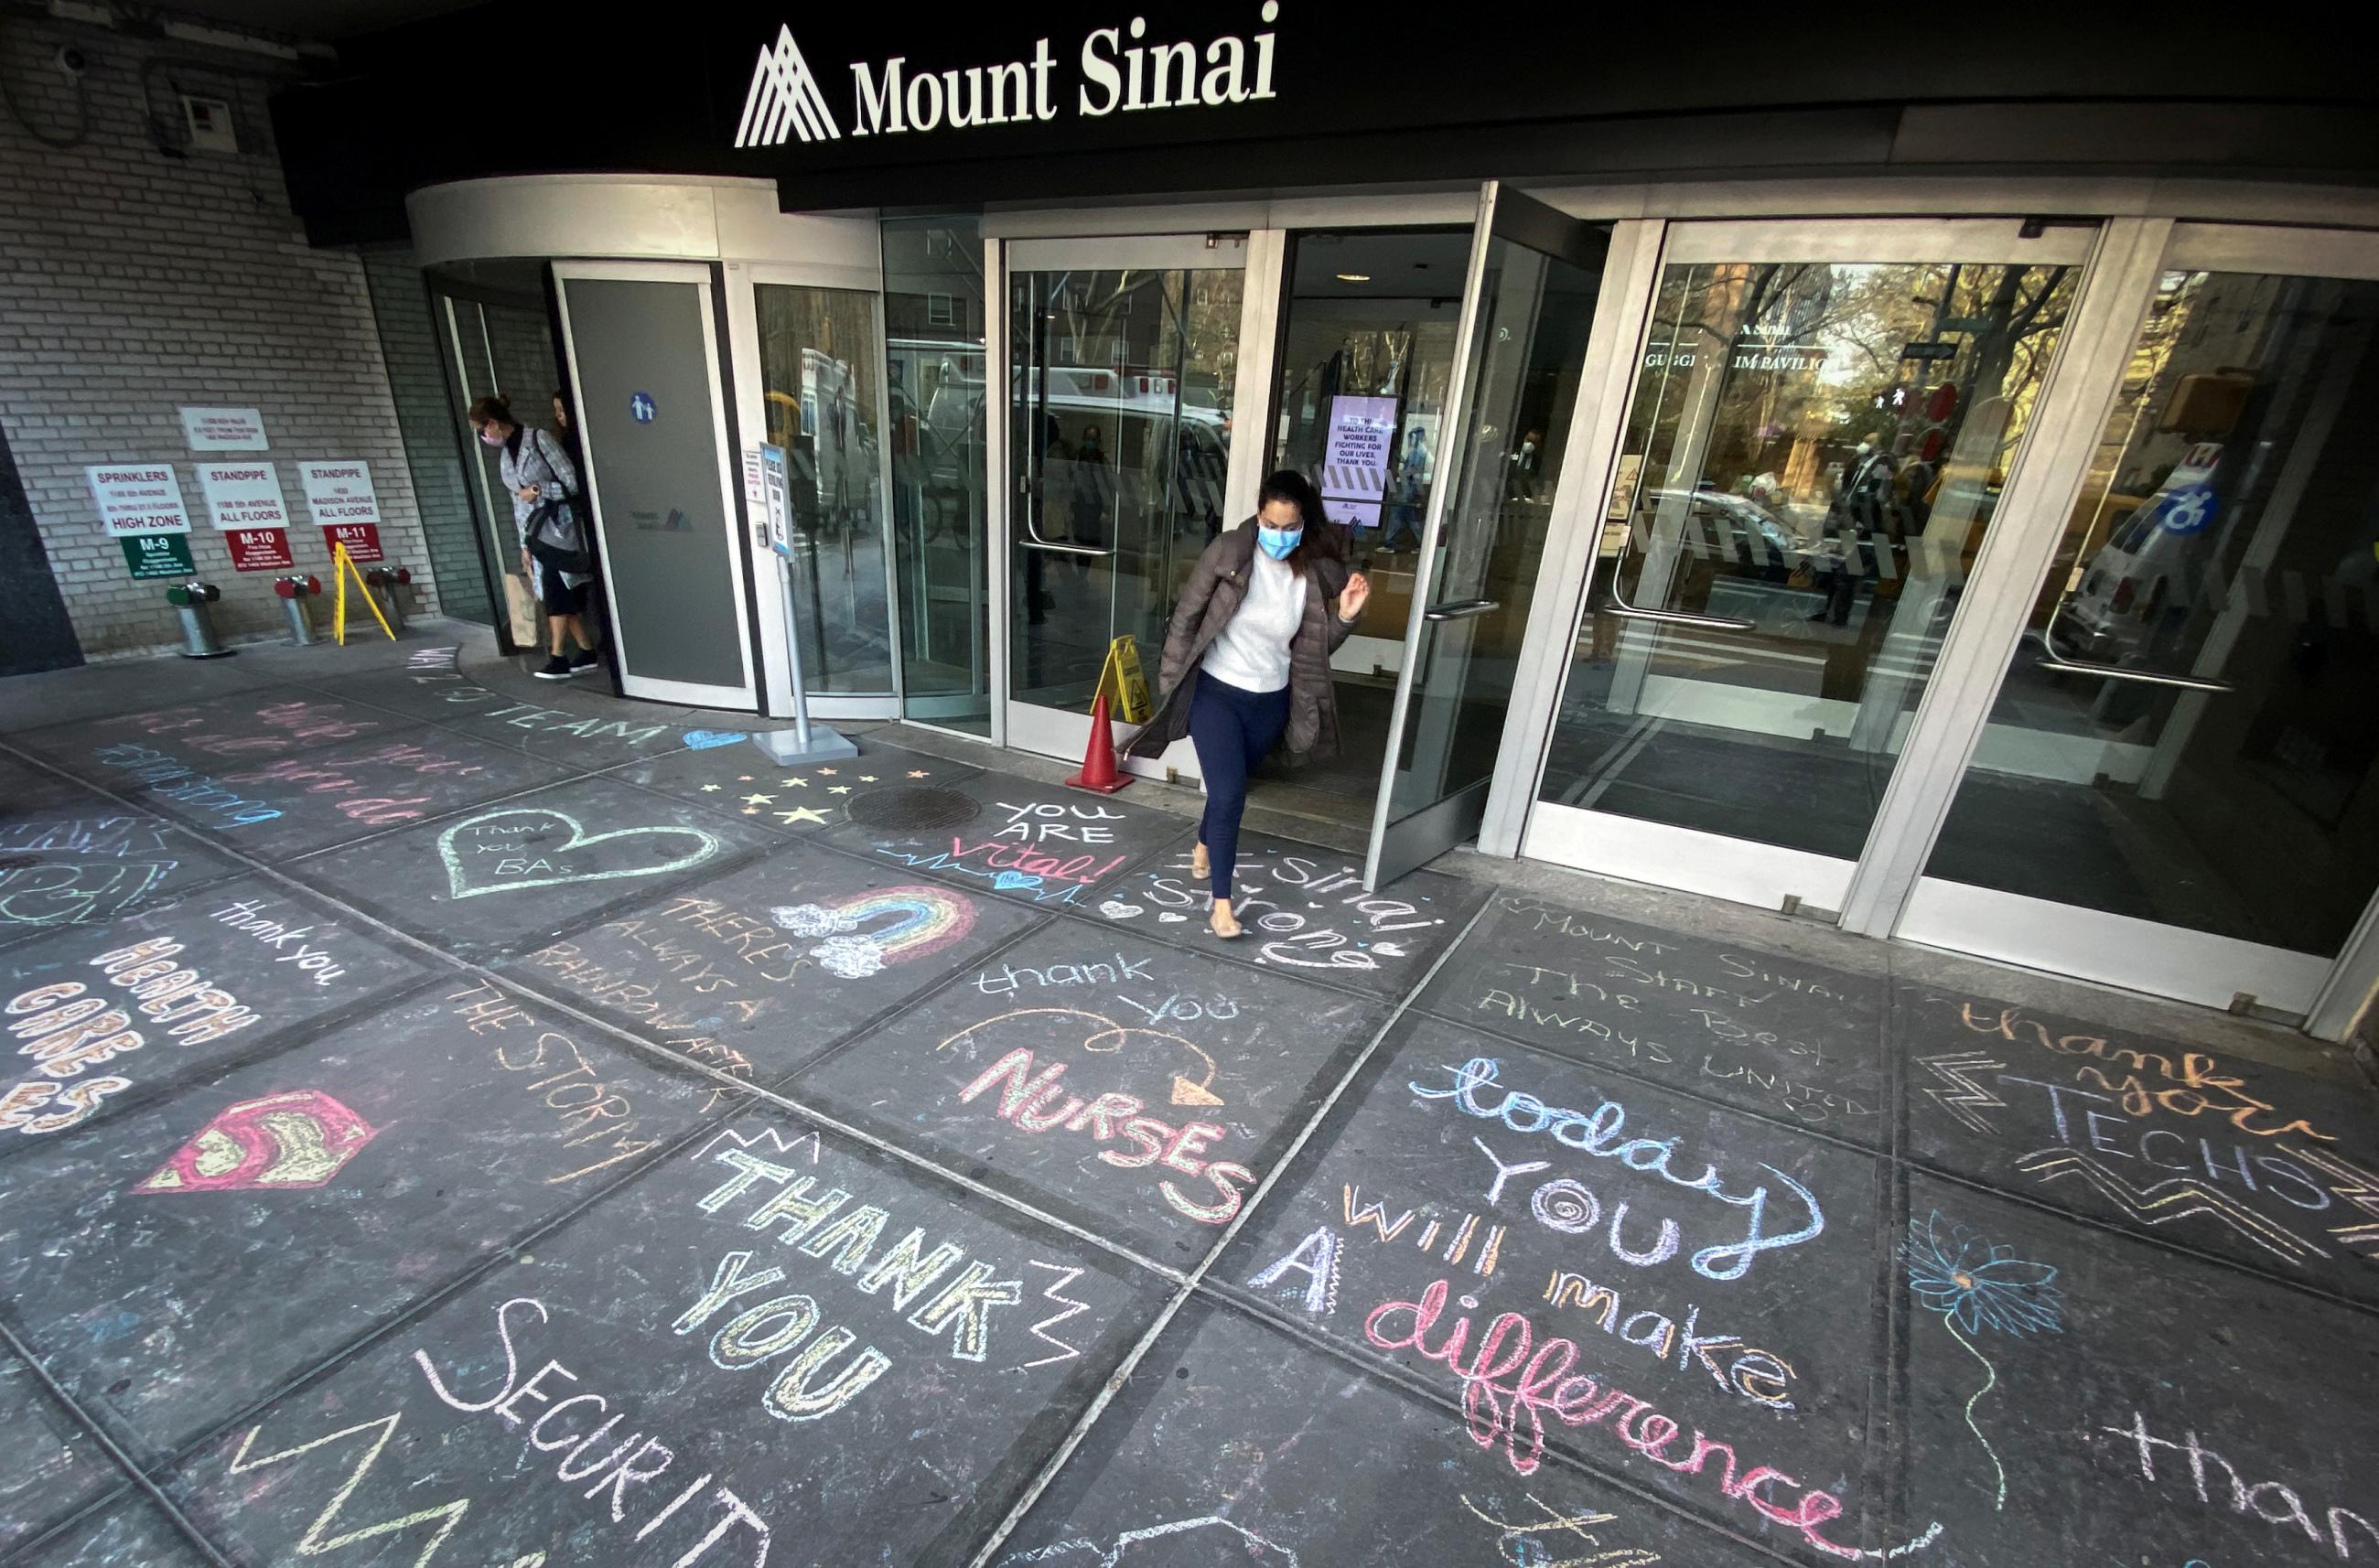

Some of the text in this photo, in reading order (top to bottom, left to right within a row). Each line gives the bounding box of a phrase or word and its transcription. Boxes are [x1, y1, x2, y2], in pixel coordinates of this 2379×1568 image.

[849, 0, 1278, 136] Mount Sinai
[1334, 441, 1366, 449] FIGHTING
[97, 471, 169, 484] SPRINKLERS
[210, 470, 267, 481] STANDPIPE
[310, 468, 362, 479] STANDPIPE
[113, 515, 183, 530] HIGH ZONE
[220, 510, 283, 523] ALL FLOORS
[312, 495, 372, 506] MADISON AVENUE
[319, 506, 374, 519] ALL FLOORS
[139, 537, 169, 551] M-9
[240, 532, 275, 545] M-10
[336, 526, 366, 540] M-11
[484, 702, 670, 746] TEAM
[992, 822, 1116, 845] ARE
[994, 800, 1127, 823] YOU
[211, 899, 346, 986] thank you
[89, 937, 262, 1047] HEALTH
[971, 952, 1155, 994] thank
[446, 978, 535, 1036] THE
[5, 982, 145, 1078] CARE
[2075, 1066, 2342, 1141] you
[1997, 1074, 2331, 1210] TECHS
[1409, 1058, 1825, 1281] today
[1472, 1136, 1680, 1267] YOU
[696, 1147, 1023, 1362] THANK
[672, 1250, 893, 1423] YOU
[1543, 1269, 1797, 1410] make
[1246, 1224, 1347, 1315] A
[1363, 1279, 1943, 1563] difference
[2102, 1412, 2379, 1558] than
